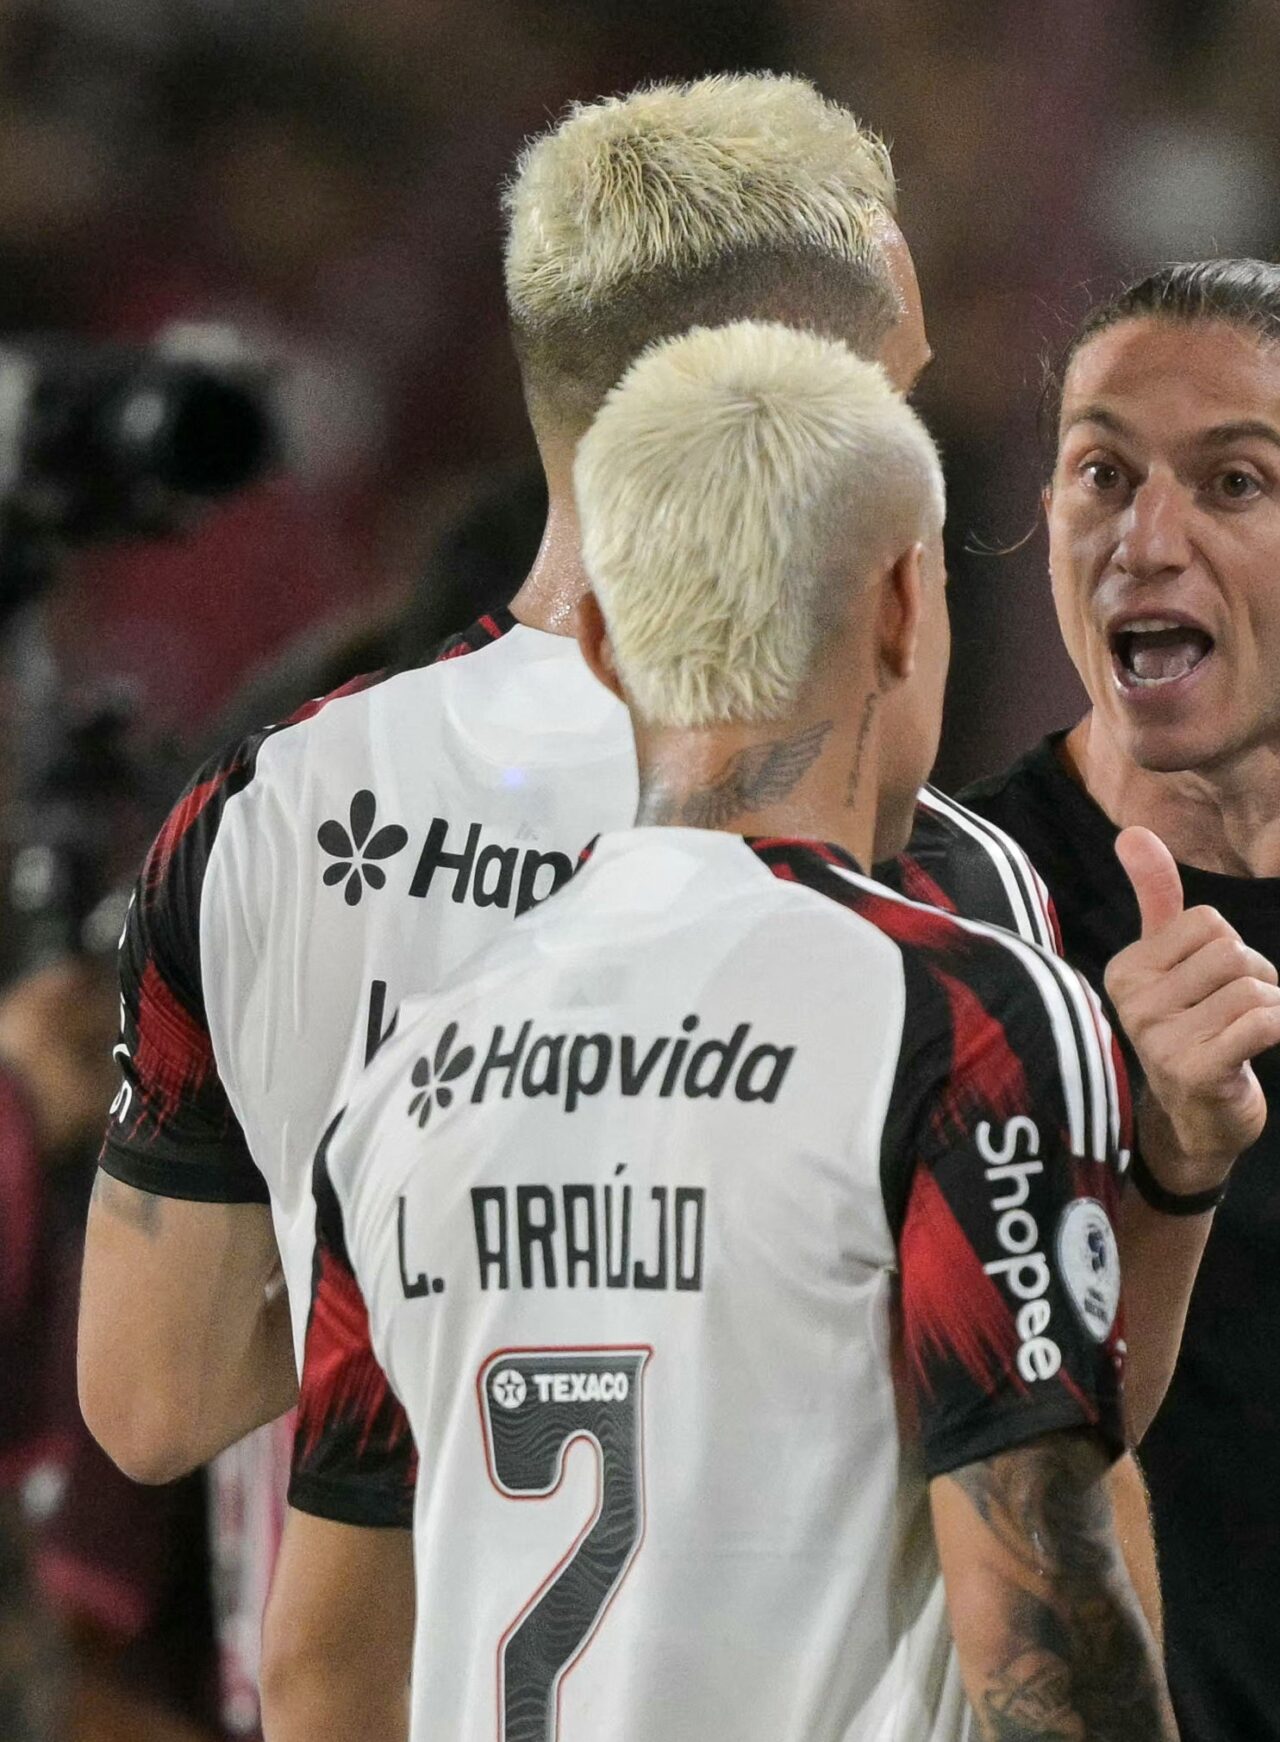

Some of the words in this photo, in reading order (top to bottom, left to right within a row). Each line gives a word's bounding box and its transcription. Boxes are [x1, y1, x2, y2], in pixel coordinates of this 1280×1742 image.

[471, 1014, 796, 1112] Hapvida
[398, 1195, 446, 1299] L.
[470, 1164, 706, 1292] ARAÚJO
[975, 1115, 1062, 1383] Shopee
[532, 1371, 630, 1403] TEXACO
[476, 1345, 654, 1742] 7
